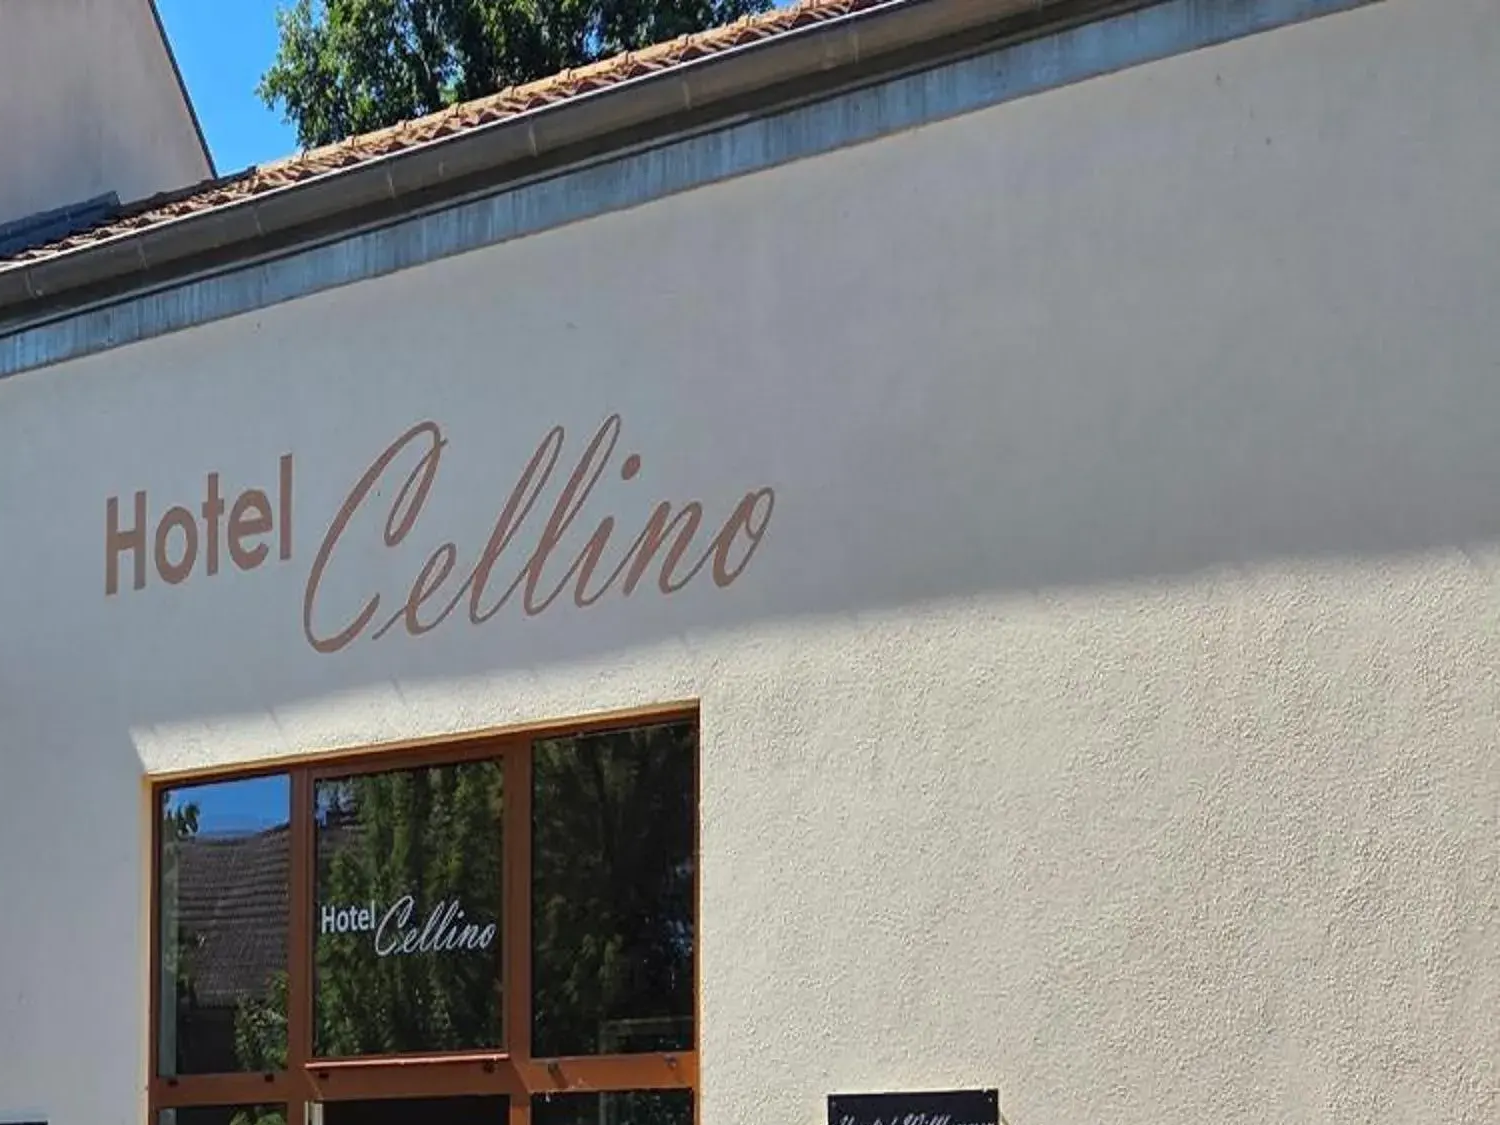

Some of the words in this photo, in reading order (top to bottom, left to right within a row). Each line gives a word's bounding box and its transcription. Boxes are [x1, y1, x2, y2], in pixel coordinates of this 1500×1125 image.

[104, 453, 293, 596] Hotel
[304, 413, 775, 654] Cellino
[321, 900, 376, 934] Hotel
[375, 895, 497, 956] Cellino
